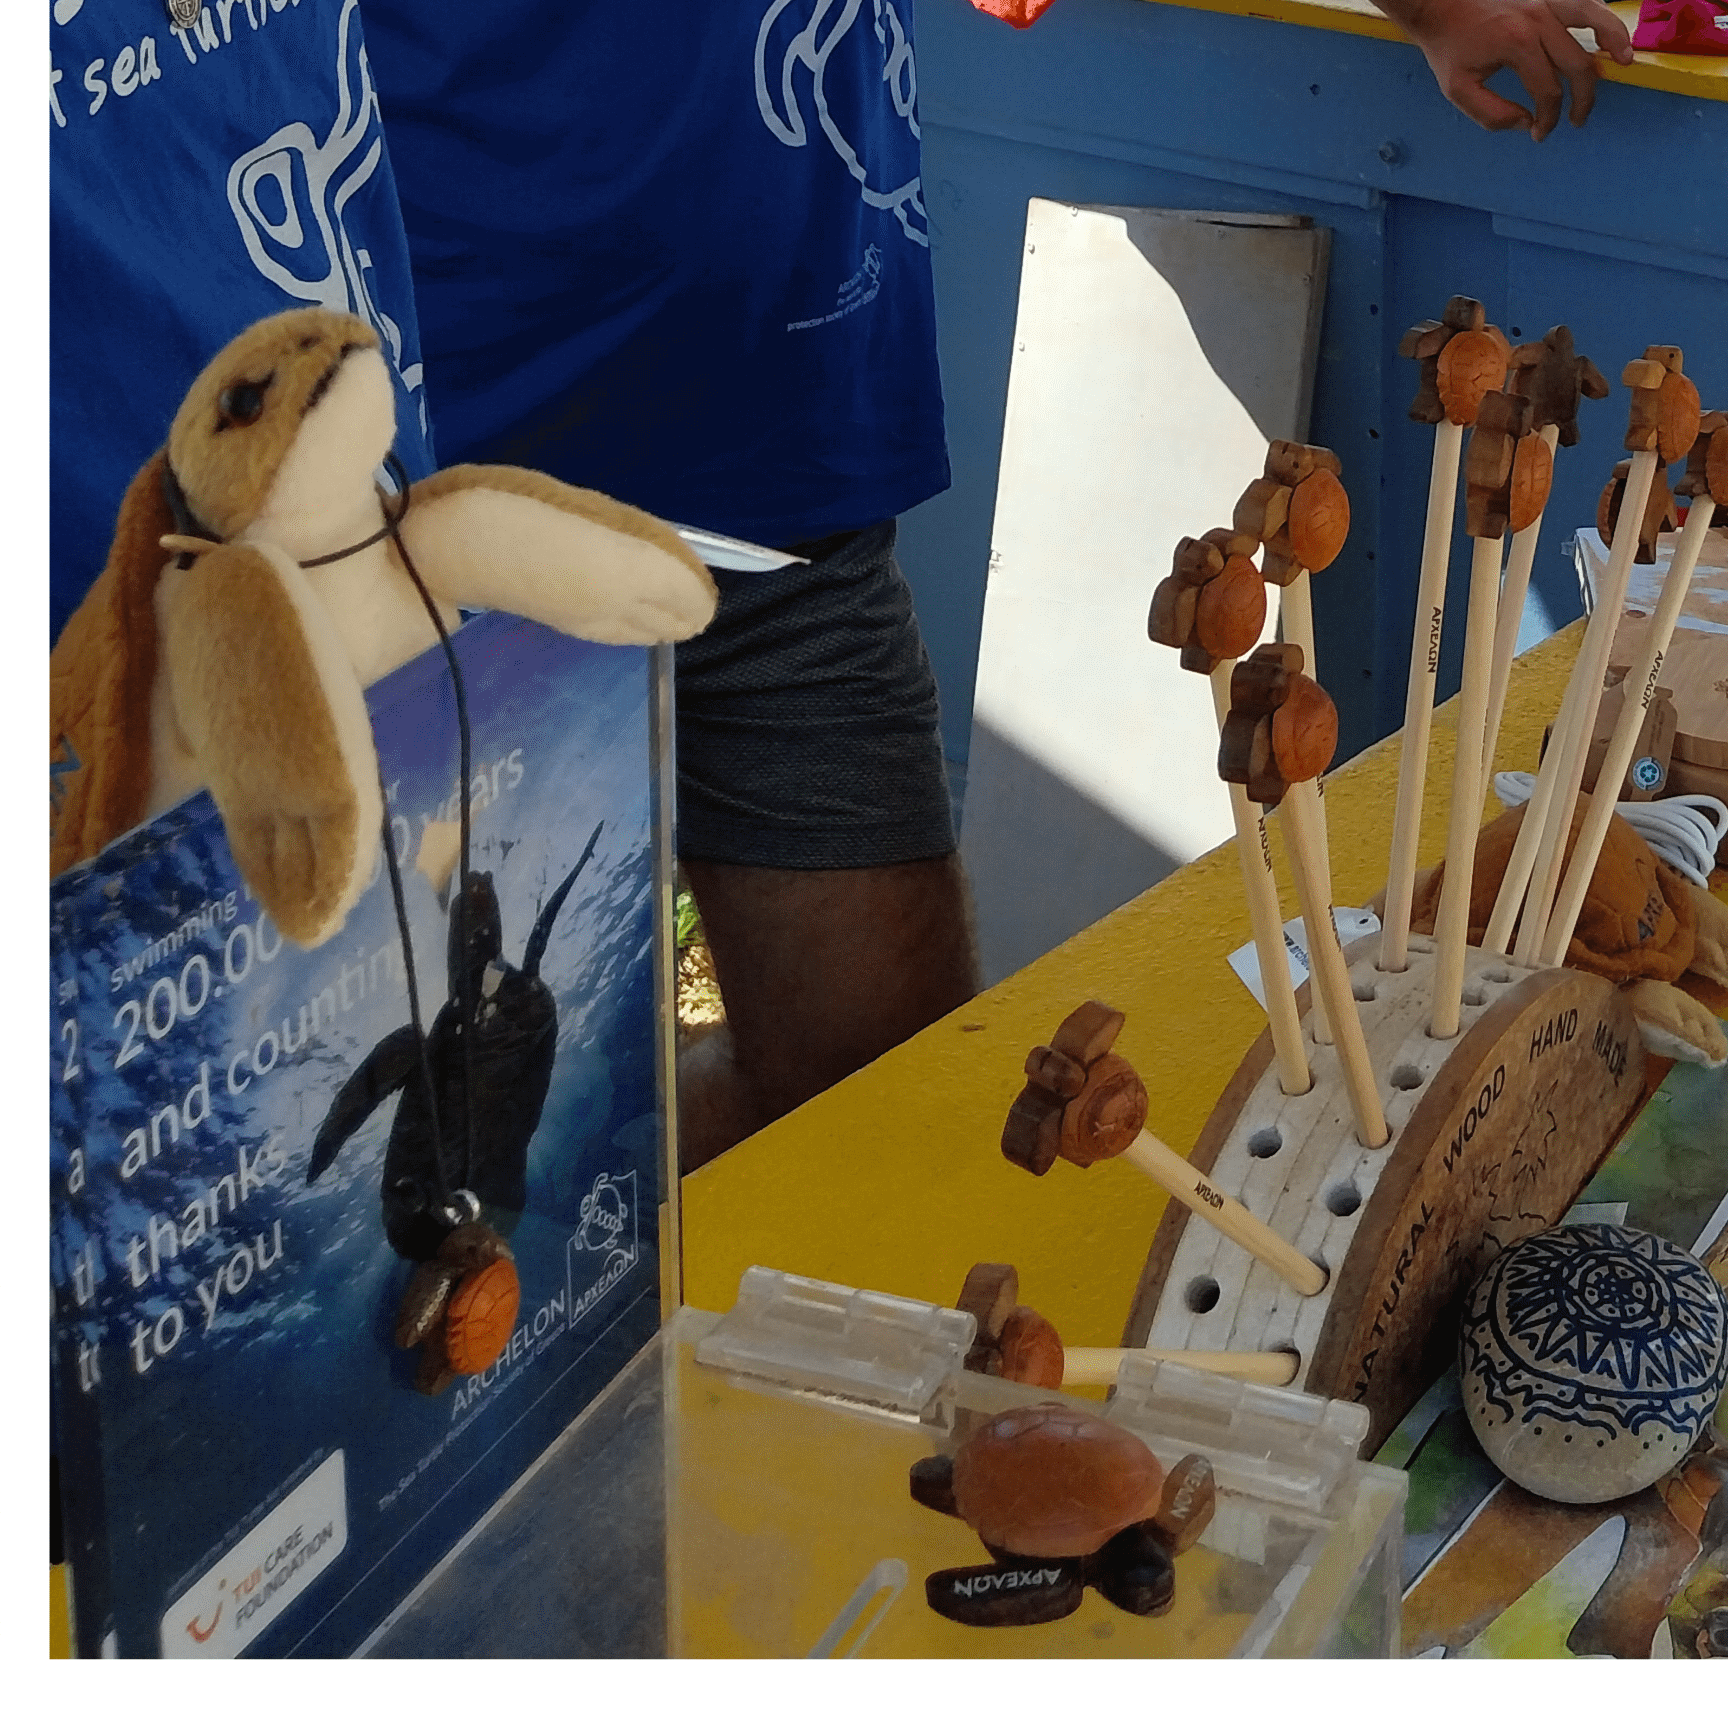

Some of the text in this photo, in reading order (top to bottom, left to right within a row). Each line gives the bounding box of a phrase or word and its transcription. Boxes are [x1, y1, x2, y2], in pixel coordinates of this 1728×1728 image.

[84, 35, 161, 115] sea
[1427, 606, 1442, 673] ΑΡΧΕΛΩΝ
[1641, 650, 1664, 710] ΑΡΧΕΛΩΝ
[111, 888, 239, 994] swimming
[121, 940, 396, 1180] and countin
[1529, 1008, 1627, 1088] HAND MADE
[1442, 1064, 1506, 1174] WOOD
[125, 1130, 287, 1289] thanks
[130, 1305, 185, 1376] to
[195, 1218, 284, 1336] you
[573, 1244, 636, 1319] ΑΡΧΕΛΩΝ
[452, 1289, 566, 1422] ARCHELON
[231, 1523, 305, 1604] TUI CARE
[234, 1520, 334, 1631] FOUNDATION
[954, 1567, 1063, 1598] ΑΡΧΕΛΩΝ
